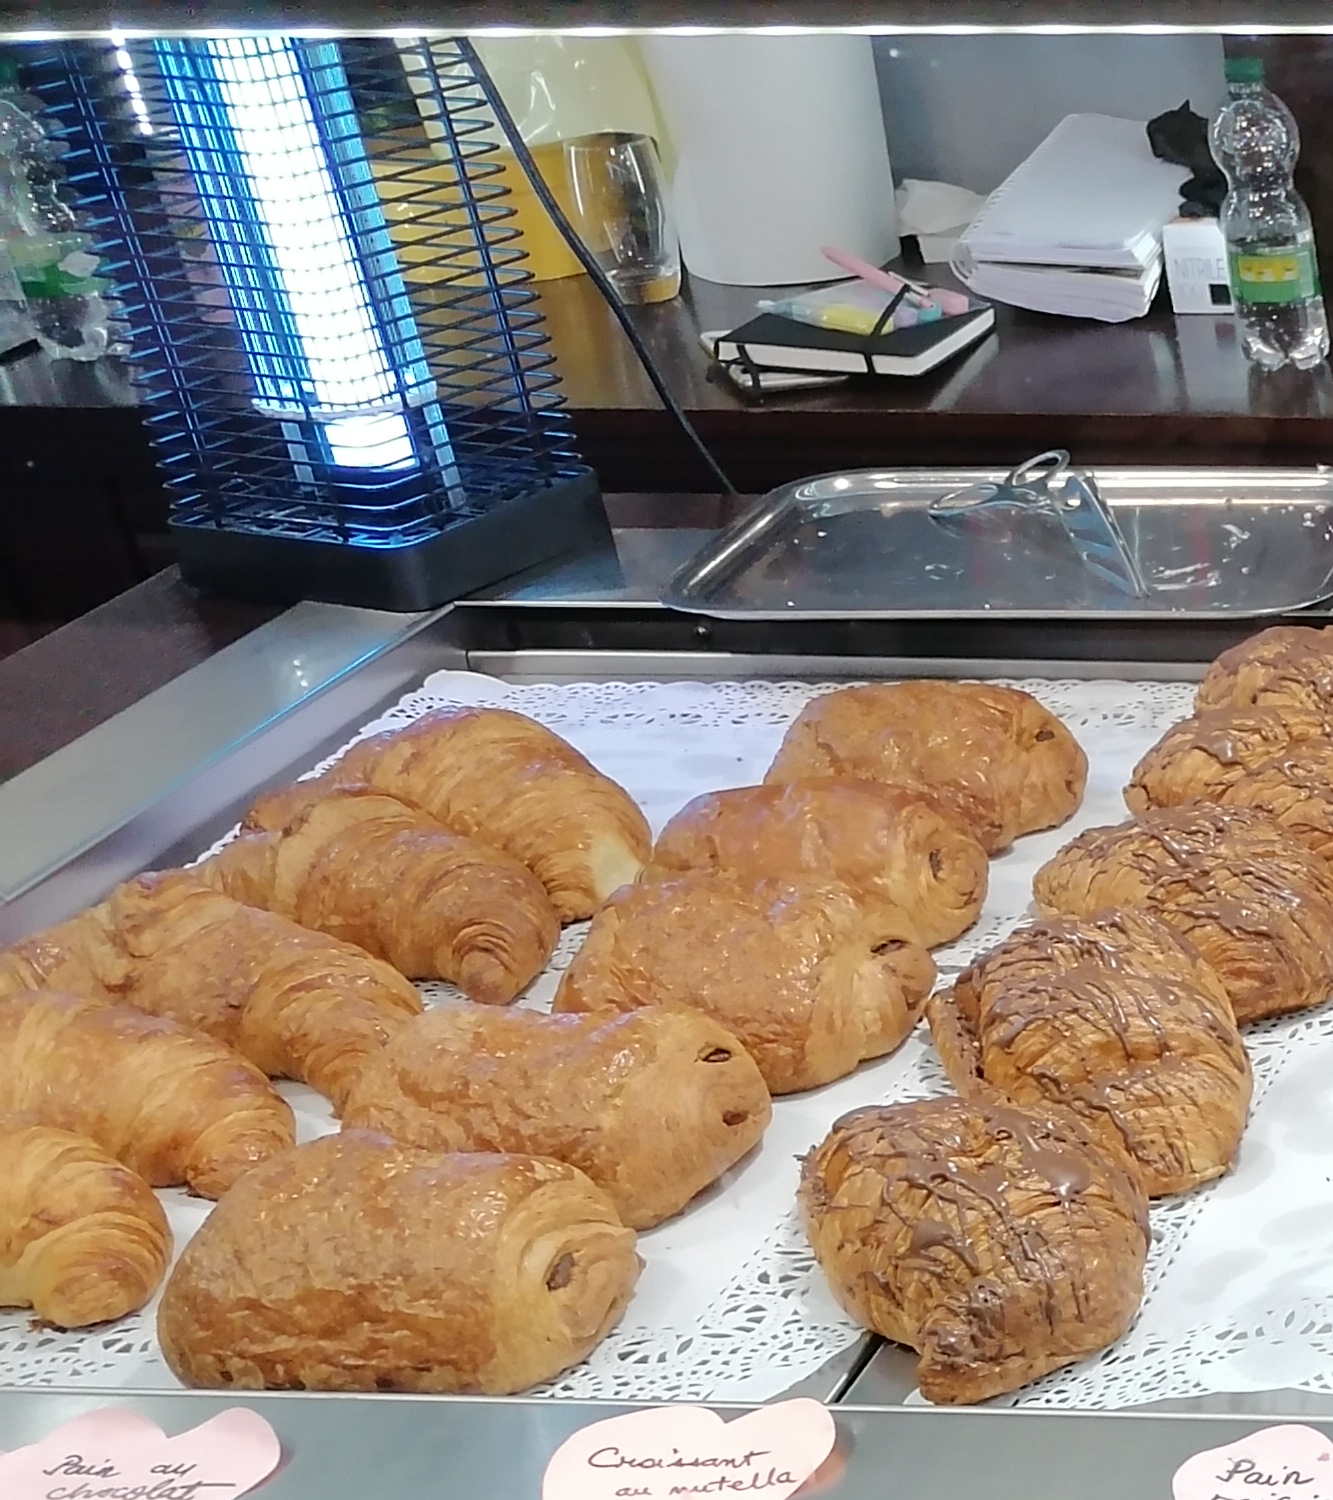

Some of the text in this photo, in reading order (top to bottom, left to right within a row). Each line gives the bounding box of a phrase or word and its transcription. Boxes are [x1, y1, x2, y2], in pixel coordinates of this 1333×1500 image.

[43, 1454, 198, 1478] Pain au
[588, 1446, 772, 1470] Croissant
[1215, 1457, 1315, 1487] Pain
